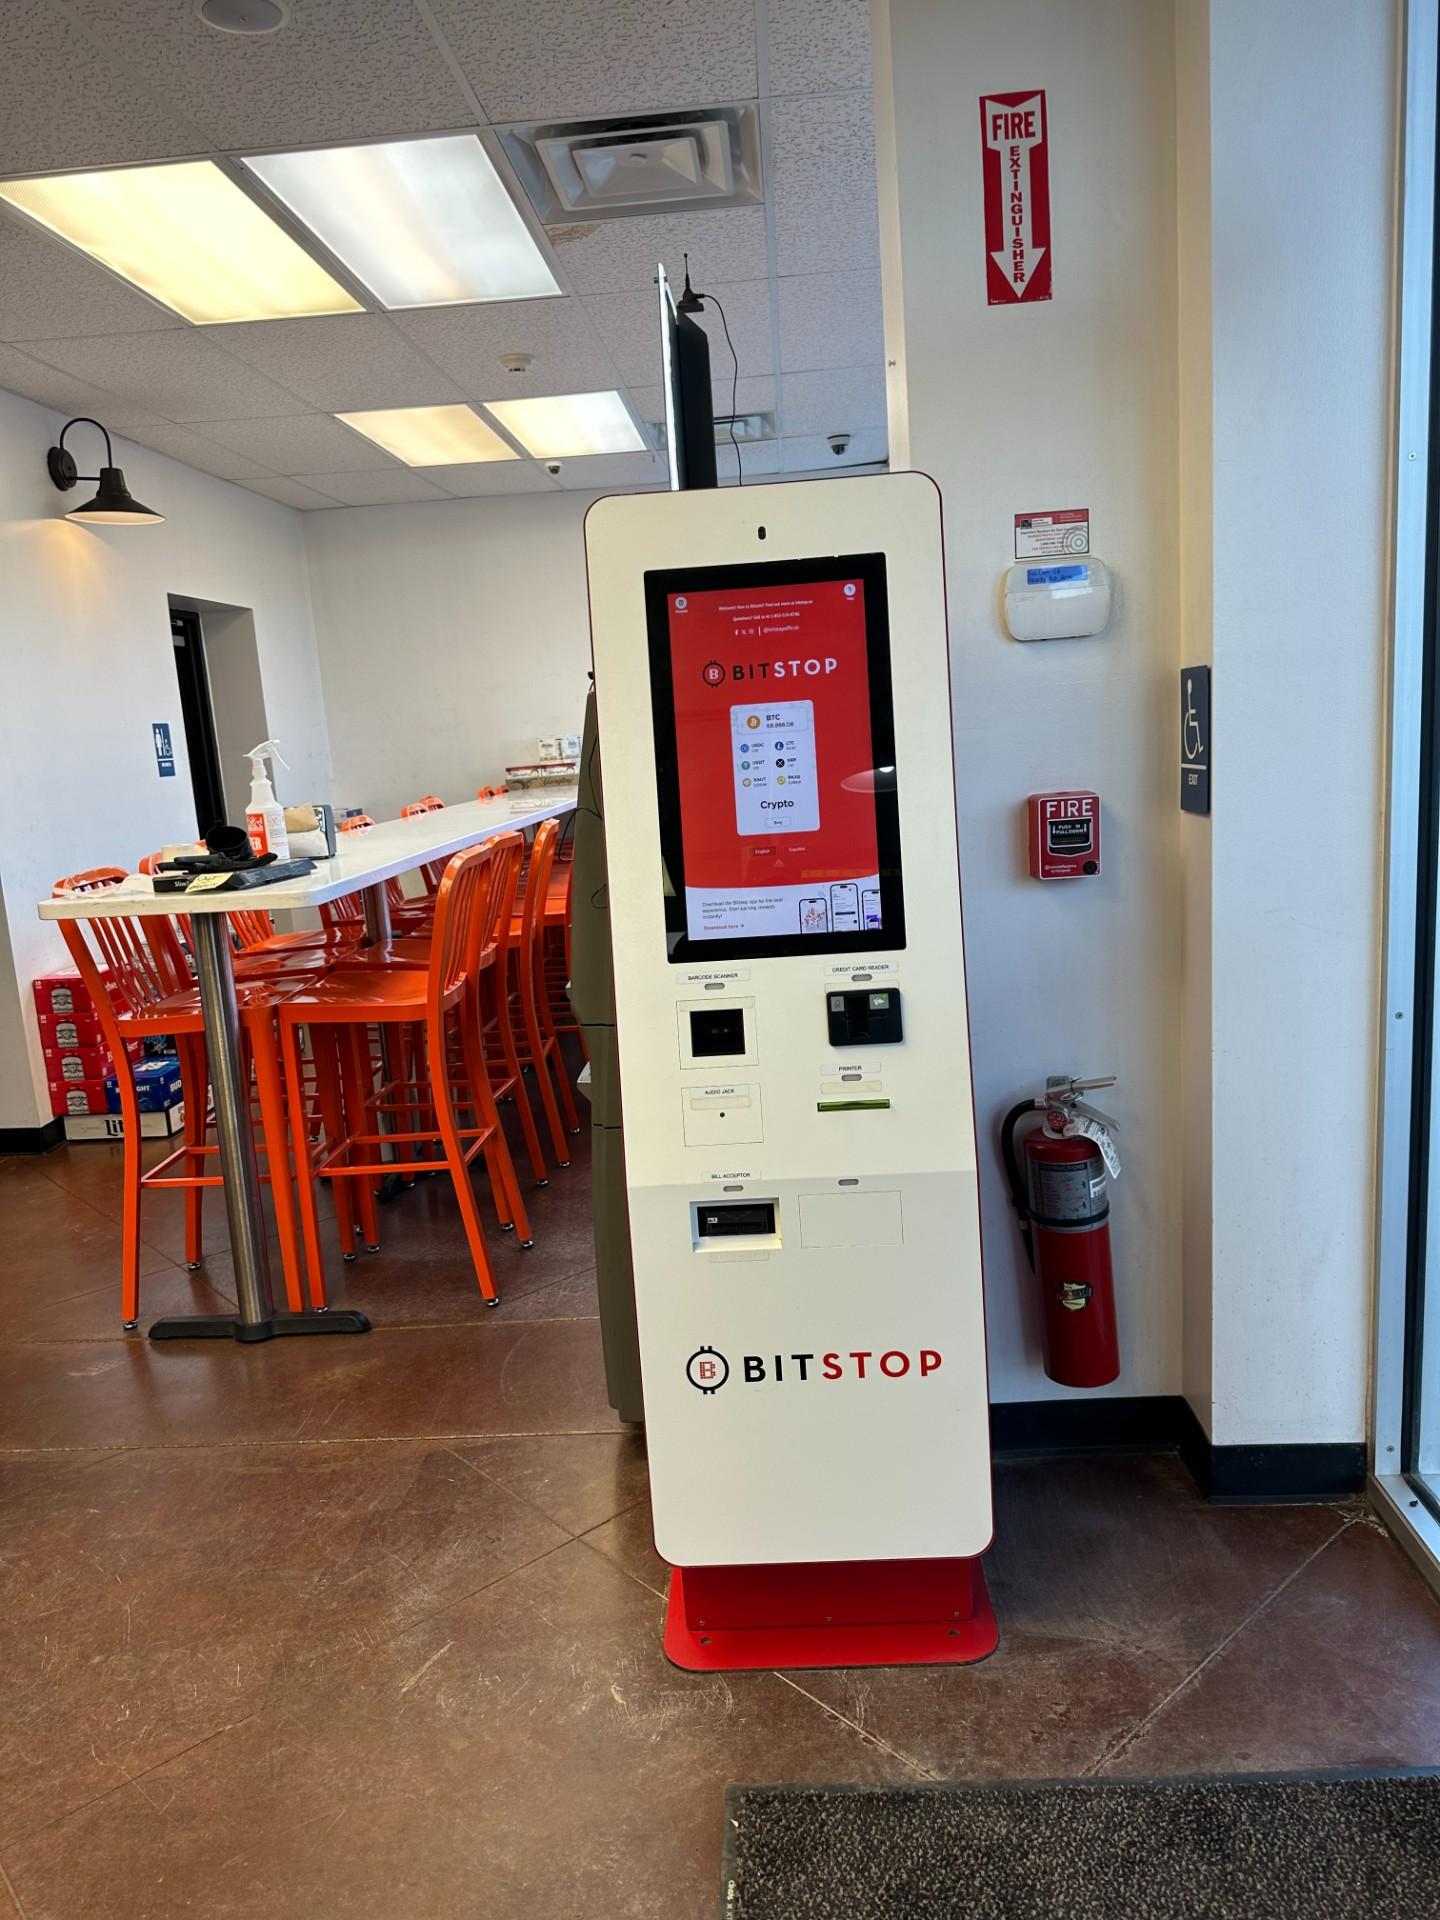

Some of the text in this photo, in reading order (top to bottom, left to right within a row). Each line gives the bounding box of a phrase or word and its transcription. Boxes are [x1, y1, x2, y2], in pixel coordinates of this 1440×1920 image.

[992, 111, 1036, 141] FIRE
[1009, 146, 1025, 283] EXTINGUISHER
[732, 657, 838, 681] BITSTOP
[1187, 773, 1199, 785] EXIT
[760, 799, 795, 811] Crypto
[1046, 799, 1093, 818] FIRE
[743, 1350, 943, 1383] BITSTOP
